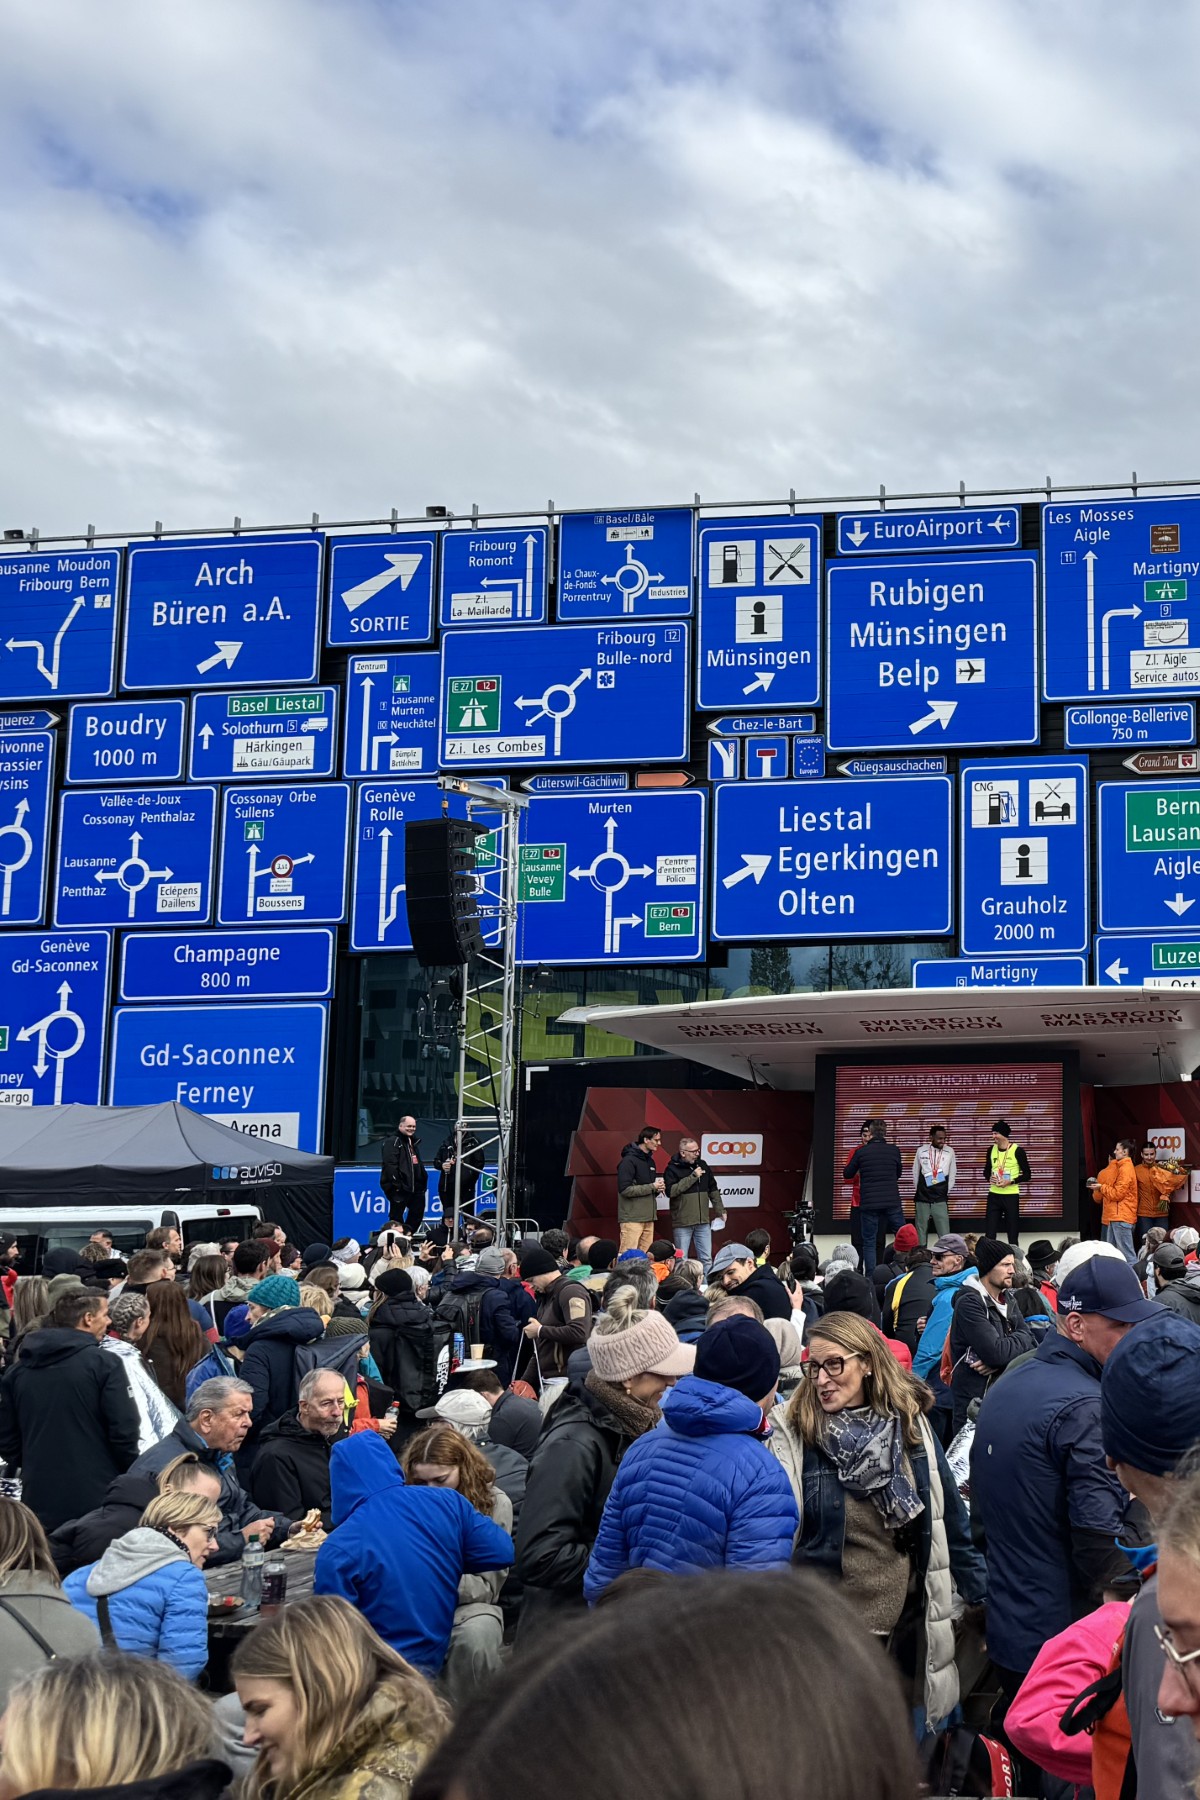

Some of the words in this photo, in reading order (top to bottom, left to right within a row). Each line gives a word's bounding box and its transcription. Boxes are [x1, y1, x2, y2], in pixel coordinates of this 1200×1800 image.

[1050, 511, 1071, 523] Les
[1081, 509, 1133, 522] Mosses
[875, 518, 982, 540] EuroAirport
[1074, 527, 1110, 544] Aigle
[470, 540, 516, 553] Fribourg
[469, 556, 513, 566] Romont
[1134, 560, 1199, 577] Martigny
[195, 559, 253, 586] Arch
[20, 578, 72, 592] Fribourg
[80, 576, 109, 588] Bern
[563, 593, 611, 602] Porrentruy
[871, 579, 983, 611] Rubigen
[153, 601, 226, 626] Büren
[243, 597, 290, 621] a.A.
[350, 616, 409, 632] SORTIE
[851, 619, 1006, 650] Münsingen
[597, 649, 671, 665] Bulle-nord
[708, 648, 810, 669] Münsingen
[880, 659, 939, 692] Belp
[1135, 672, 1167, 683] Service
[1173, 672, 1198, 681] autos
[233, 698, 268, 712] Basel
[276, 696, 319, 710] Liestal
[732, 717, 802, 730] Chez-le-Bart
[1071, 708, 1188, 727] Collonge-Bellerive
[86, 713, 166, 739] Boudry
[222, 721, 283, 735] Solothurn
[246, 740, 302, 754] Härkingen
[94, 749, 134, 766] 1000
[142, 752, 156, 765] m
[251, 756, 311, 767] Gäu/Gäupark
[974, 782, 993, 791] CNG
[100, 794, 180, 807] Vallée-de-Joux
[230, 794, 283, 806] Cossonay
[290, 791, 316, 802] Orbe
[365, 790, 415, 803] Genève
[235, 807, 274, 818] Sullens
[371, 807, 403, 821] Rolle
[589, 803, 631, 813] Murten
[83, 814, 134, 826] Cossonay
[141, 811, 195, 823] Penthalaz
[780, 803, 870, 832] Liestal
[65, 857, 116, 867] Lausanne
[779, 843, 937, 879] Egerkingen
[527, 875, 555, 886] Vevey
[63, 886, 106, 896] Penthaz
[530, 887, 551, 896] Bulle
[259, 899, 302, 907] Boussens
[779, 888, 854, 915] Olten
[982, 895, 1067, 915] Grauholz
[660, 922, 680, 931] Bern
[994, 924, 1033, 940] 2000
[1041, 927, 1054, 938] m
[41, 939, 89, 953] Genève
[174, 945, 280, 966] Champagne
[12, 959, 98, 973] Gd-Saconnex
[201, 972, 230, 987] 800
[237, 976, 249, 986] m
[972, 966, 1038, 982] Martigny
[1044, 1016, 1182, 1027] MARATHON
[141, 1043, 294, 1066] Gd-Saconnex
[976, 1073, 1038, 1085] WINNERS
[176, 1086, 254, 1108] Ferney
[707, 1141, 756, 1158] coop
